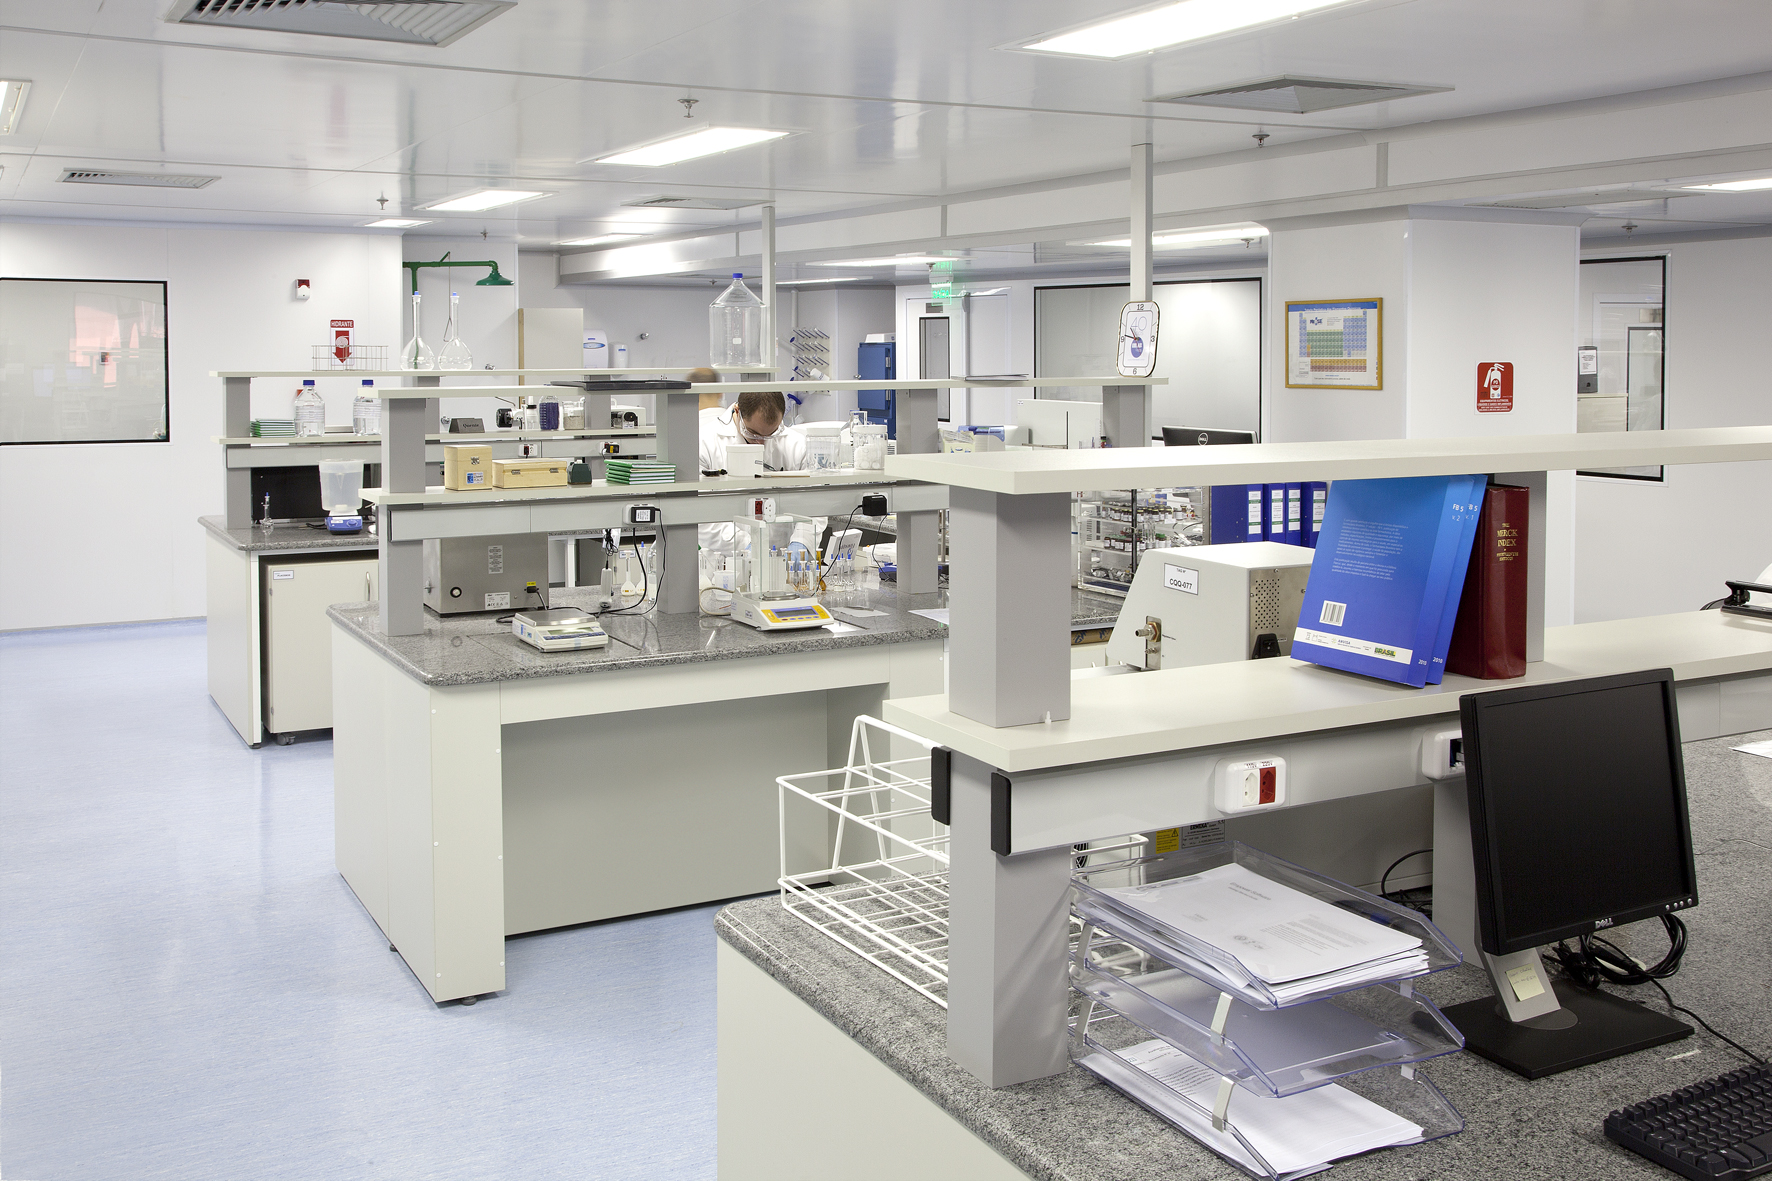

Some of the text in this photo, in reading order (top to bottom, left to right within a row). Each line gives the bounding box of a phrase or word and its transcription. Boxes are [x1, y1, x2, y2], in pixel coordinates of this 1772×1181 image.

[1496, 529, 1518, 537] MERCK
[1498, 538, 1516, 546] INDEX
[1170, 578, 1192, 590] CQQ-077
[1374, 646, 1396, 657] BRASIL
[1418, 658, 1428, 666] 2010
[1432, 656, 1443, 664] 2010
[1595, 918, 1614, 930] DELL
